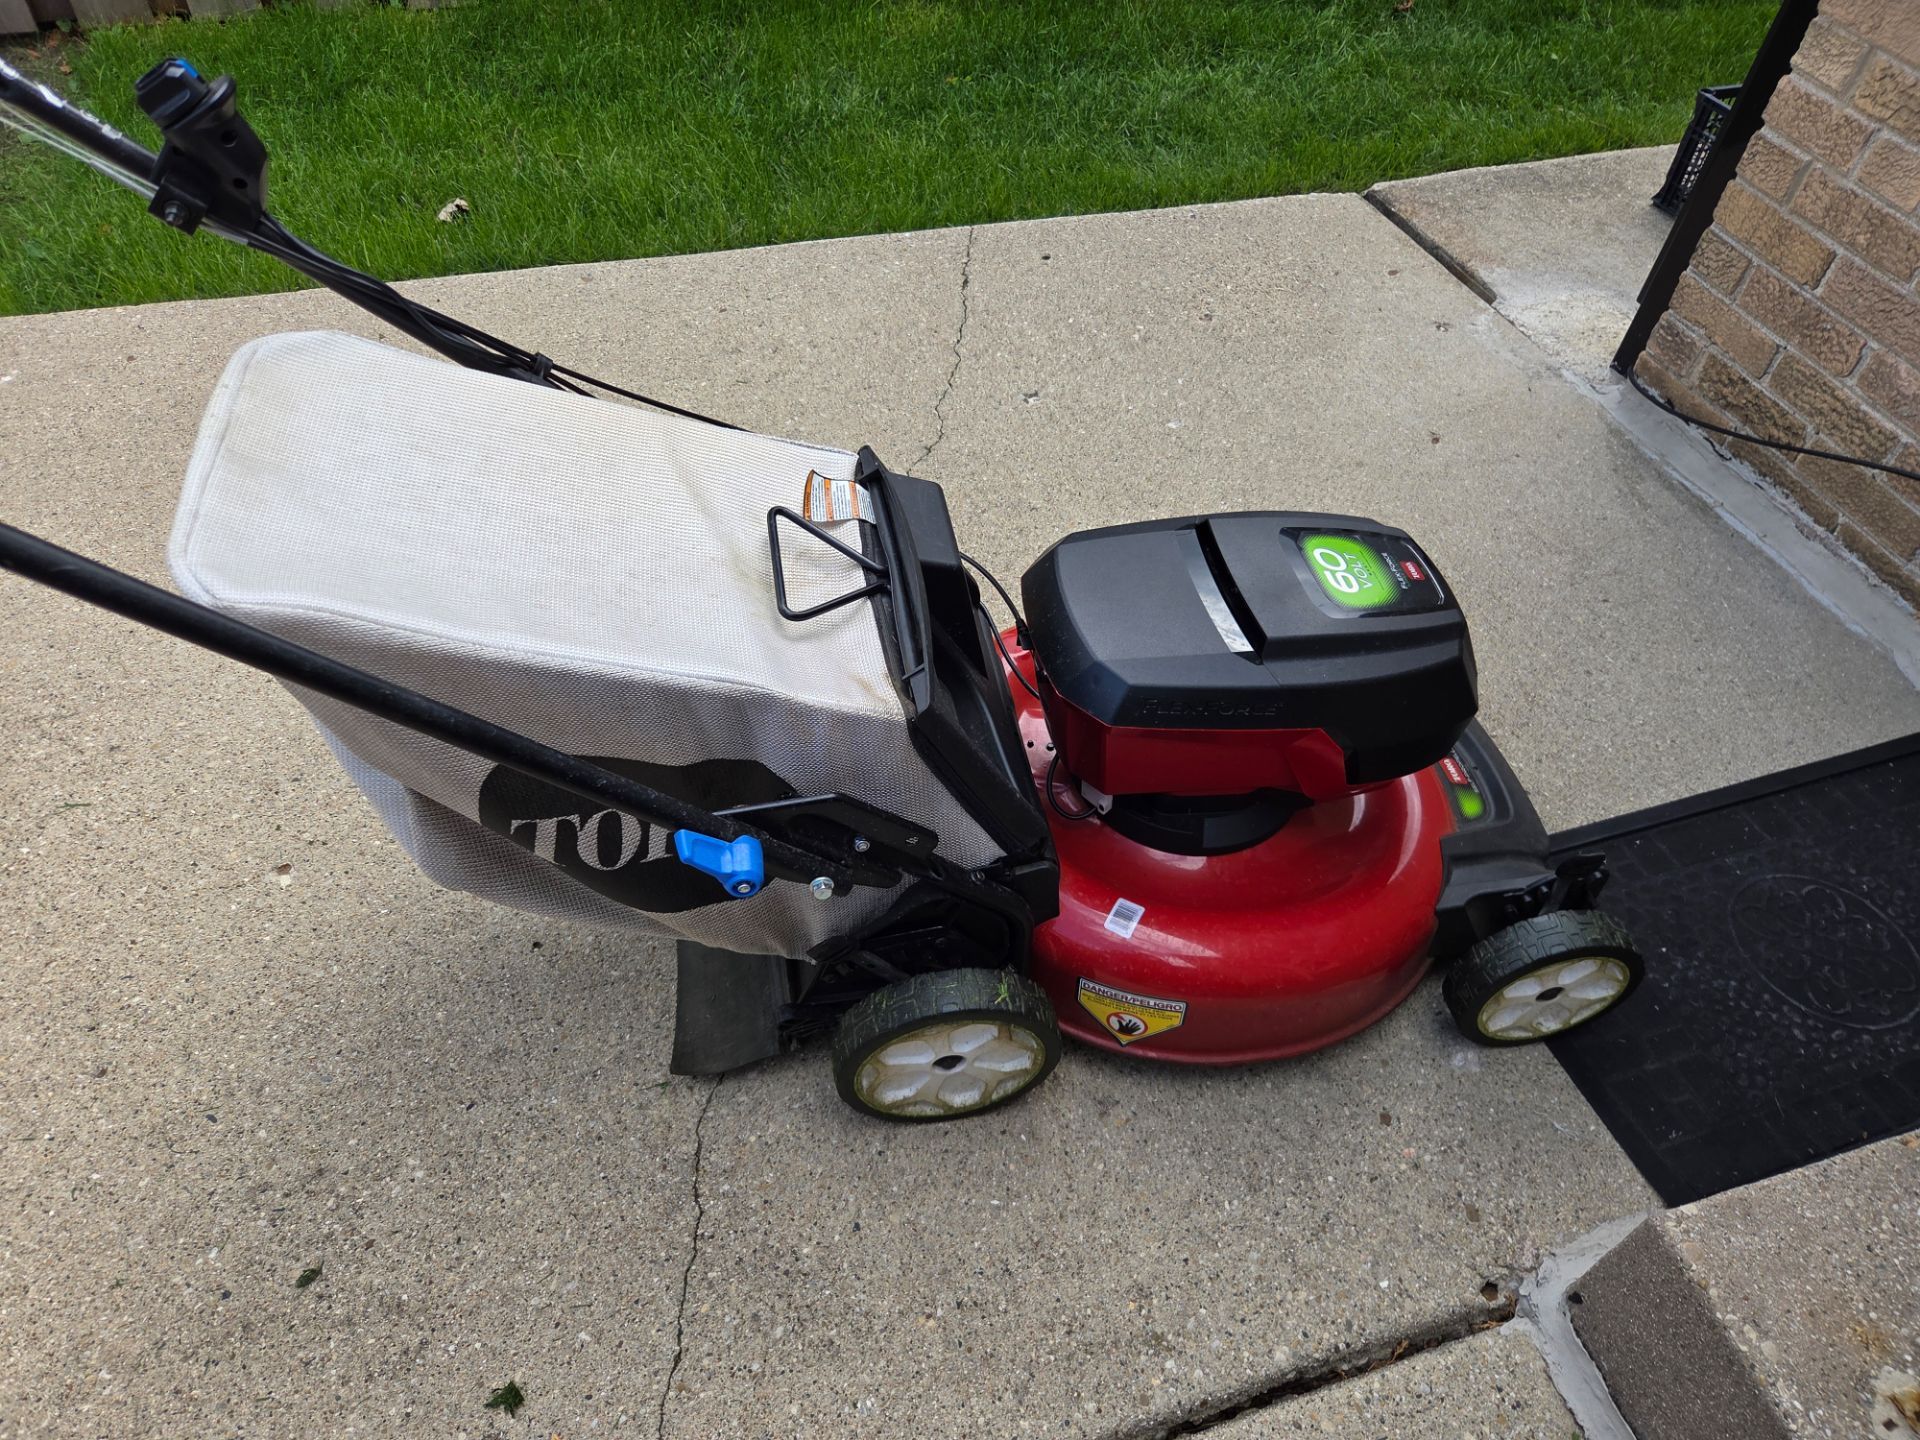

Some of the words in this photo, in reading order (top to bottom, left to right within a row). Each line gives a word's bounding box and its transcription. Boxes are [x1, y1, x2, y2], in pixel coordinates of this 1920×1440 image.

[1313, 548, 1360, 593] 60
[1343, 551, 1373, 589] VOLT
[1082, 982, 1182, 1011] DANGER/PELIGRO
